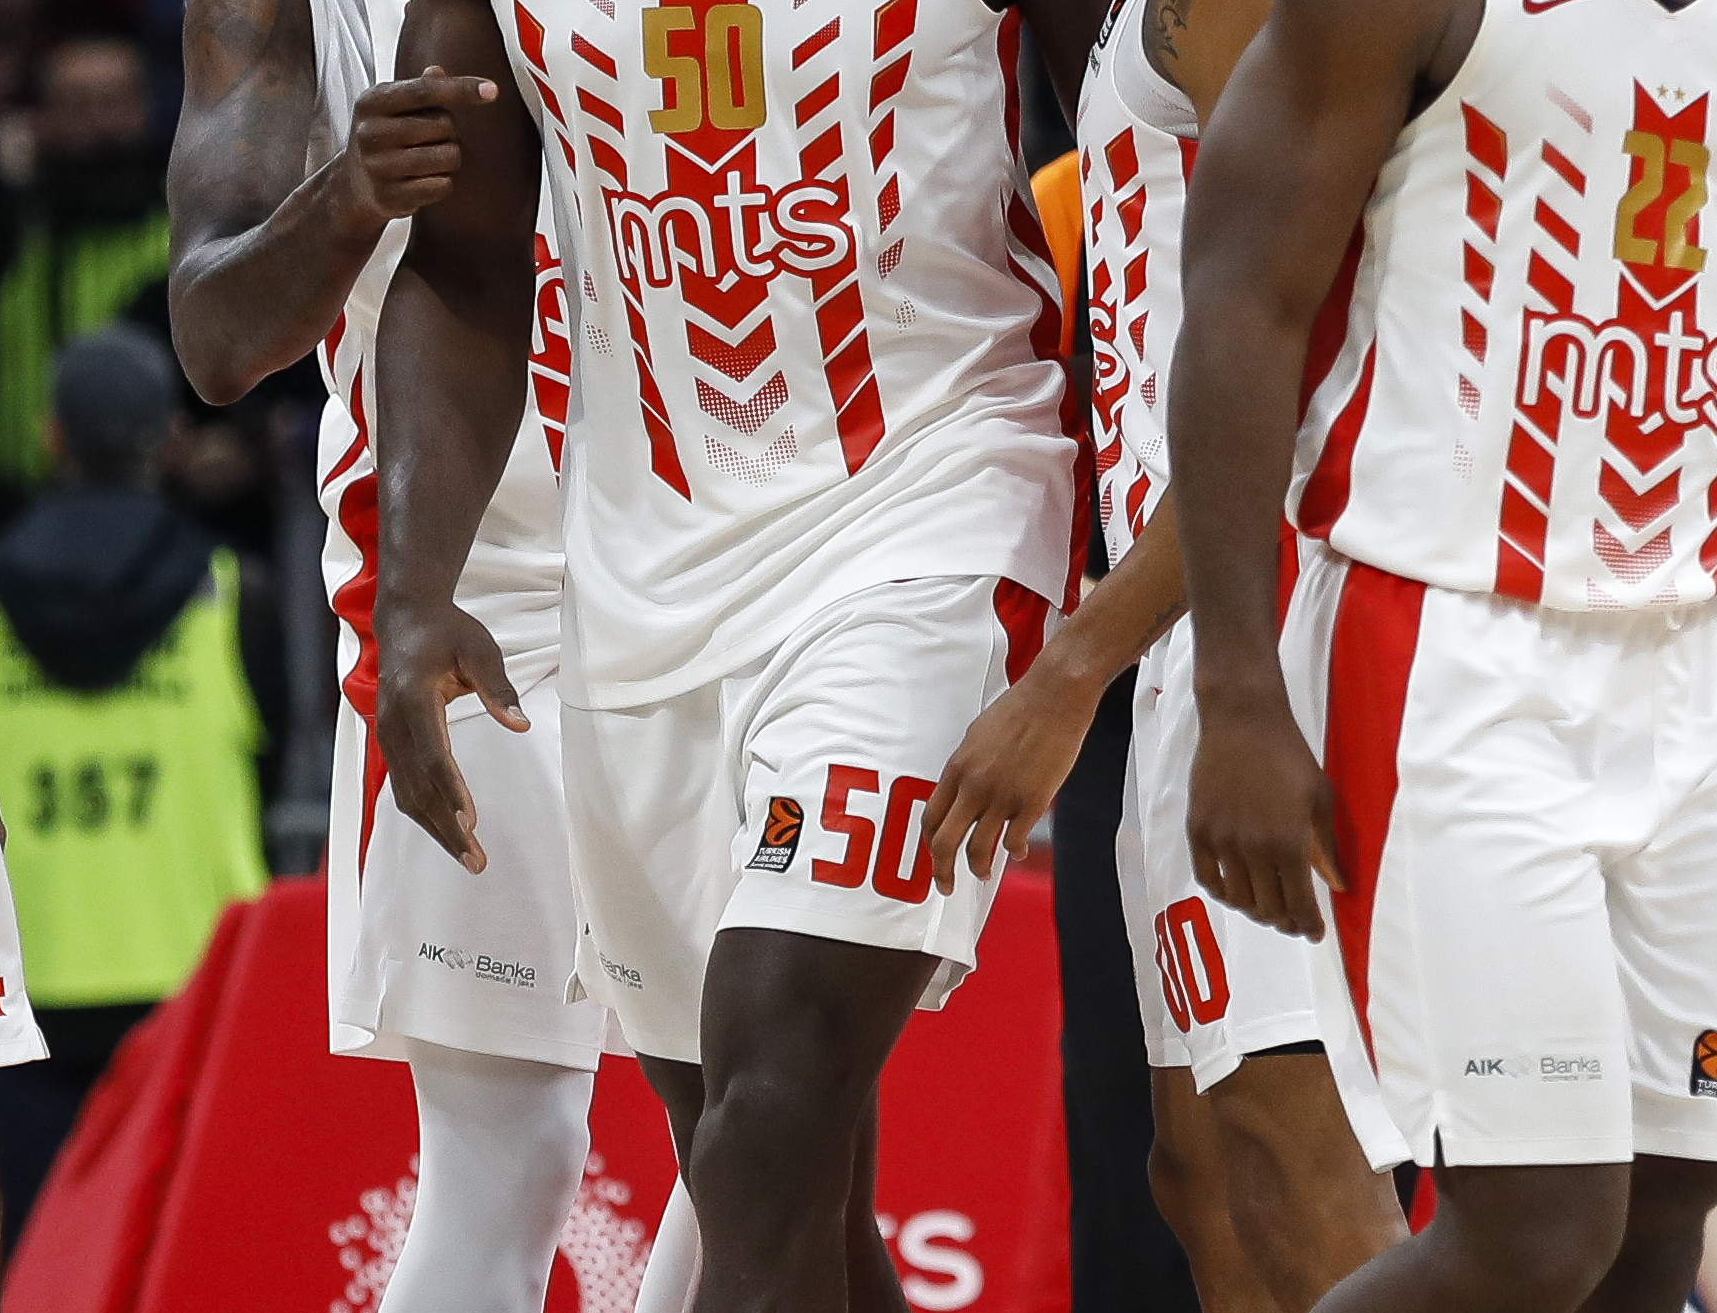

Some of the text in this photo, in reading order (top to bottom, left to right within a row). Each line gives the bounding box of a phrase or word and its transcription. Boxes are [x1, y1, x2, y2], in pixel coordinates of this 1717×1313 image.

[642, 4, 766, 133] 50
[608, 169, 851, 281] mts
[1614, 130, 1711, 272] 22
[811, 763, 940, 904] 50
[418, 942, 536, 980] AIK Banka
[1464, 1057, 1601, 1076] AIK Banka
